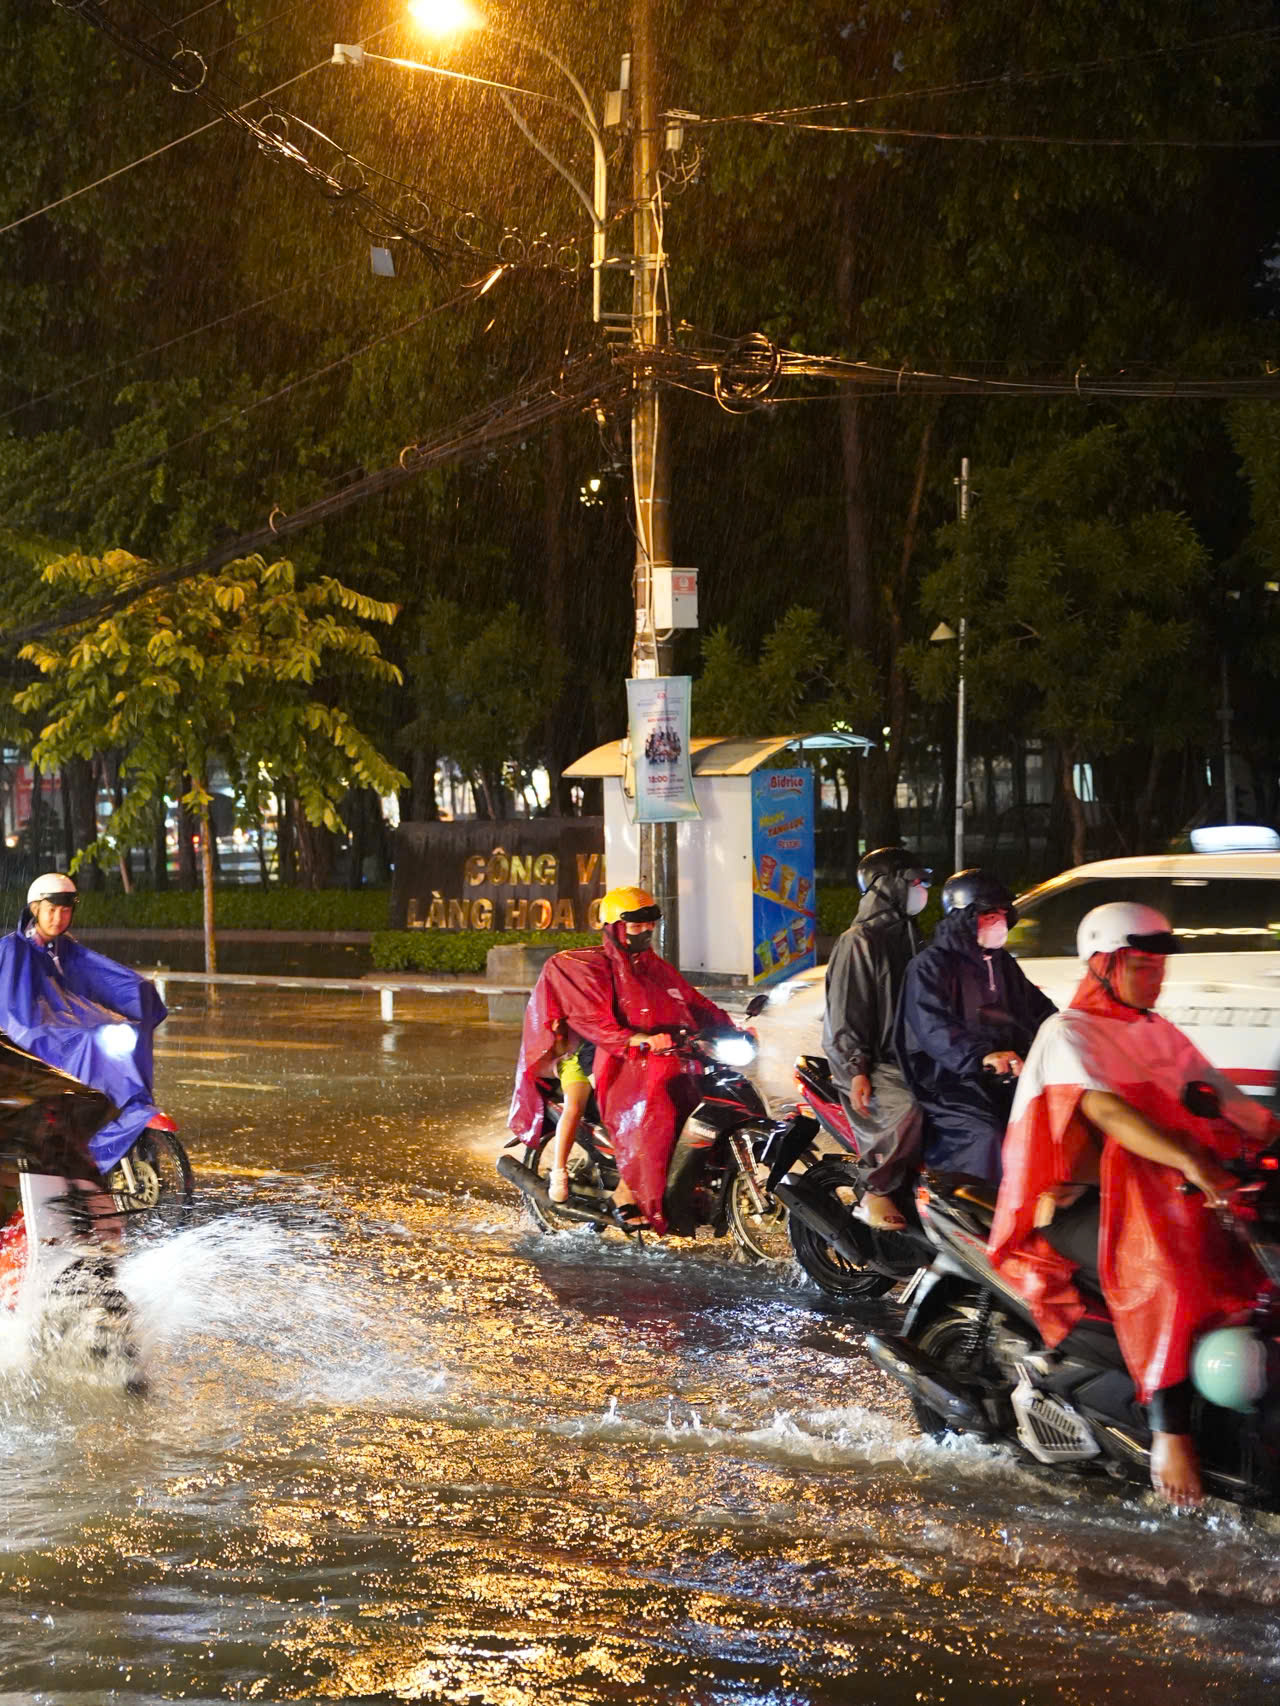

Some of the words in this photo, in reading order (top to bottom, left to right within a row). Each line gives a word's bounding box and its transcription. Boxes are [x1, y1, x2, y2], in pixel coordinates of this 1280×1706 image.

[465, 847, 558, 886] CÔNG
[406, 890, 494, 930] LÀNG
[504, 898, 575, 930] HOA
